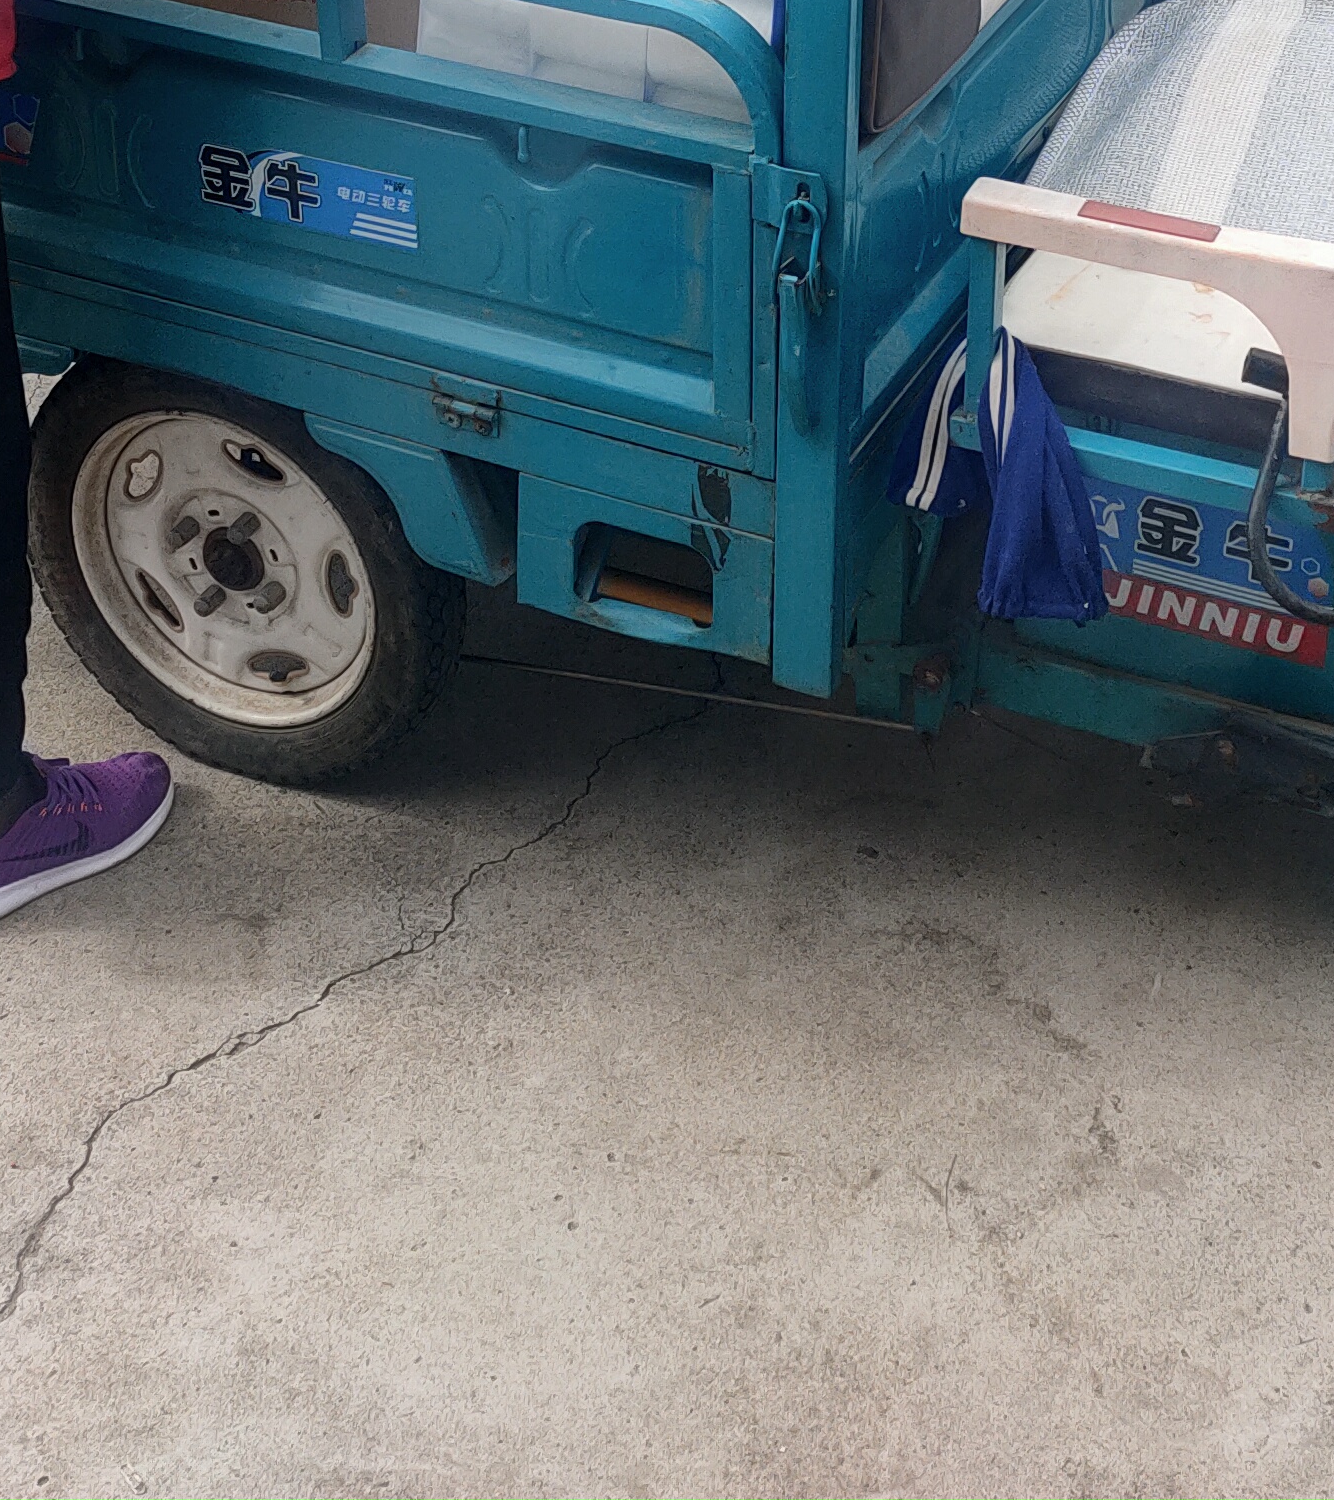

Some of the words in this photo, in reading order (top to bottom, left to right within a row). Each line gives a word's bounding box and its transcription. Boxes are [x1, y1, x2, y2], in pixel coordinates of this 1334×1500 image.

[199, 143, 321, 223] 金牛
[337, 186, 412, 213] 电动三轮车
[1134, 495, 1294, 584] 金牛
[1104, 578, 1305, 653] JINNIU
